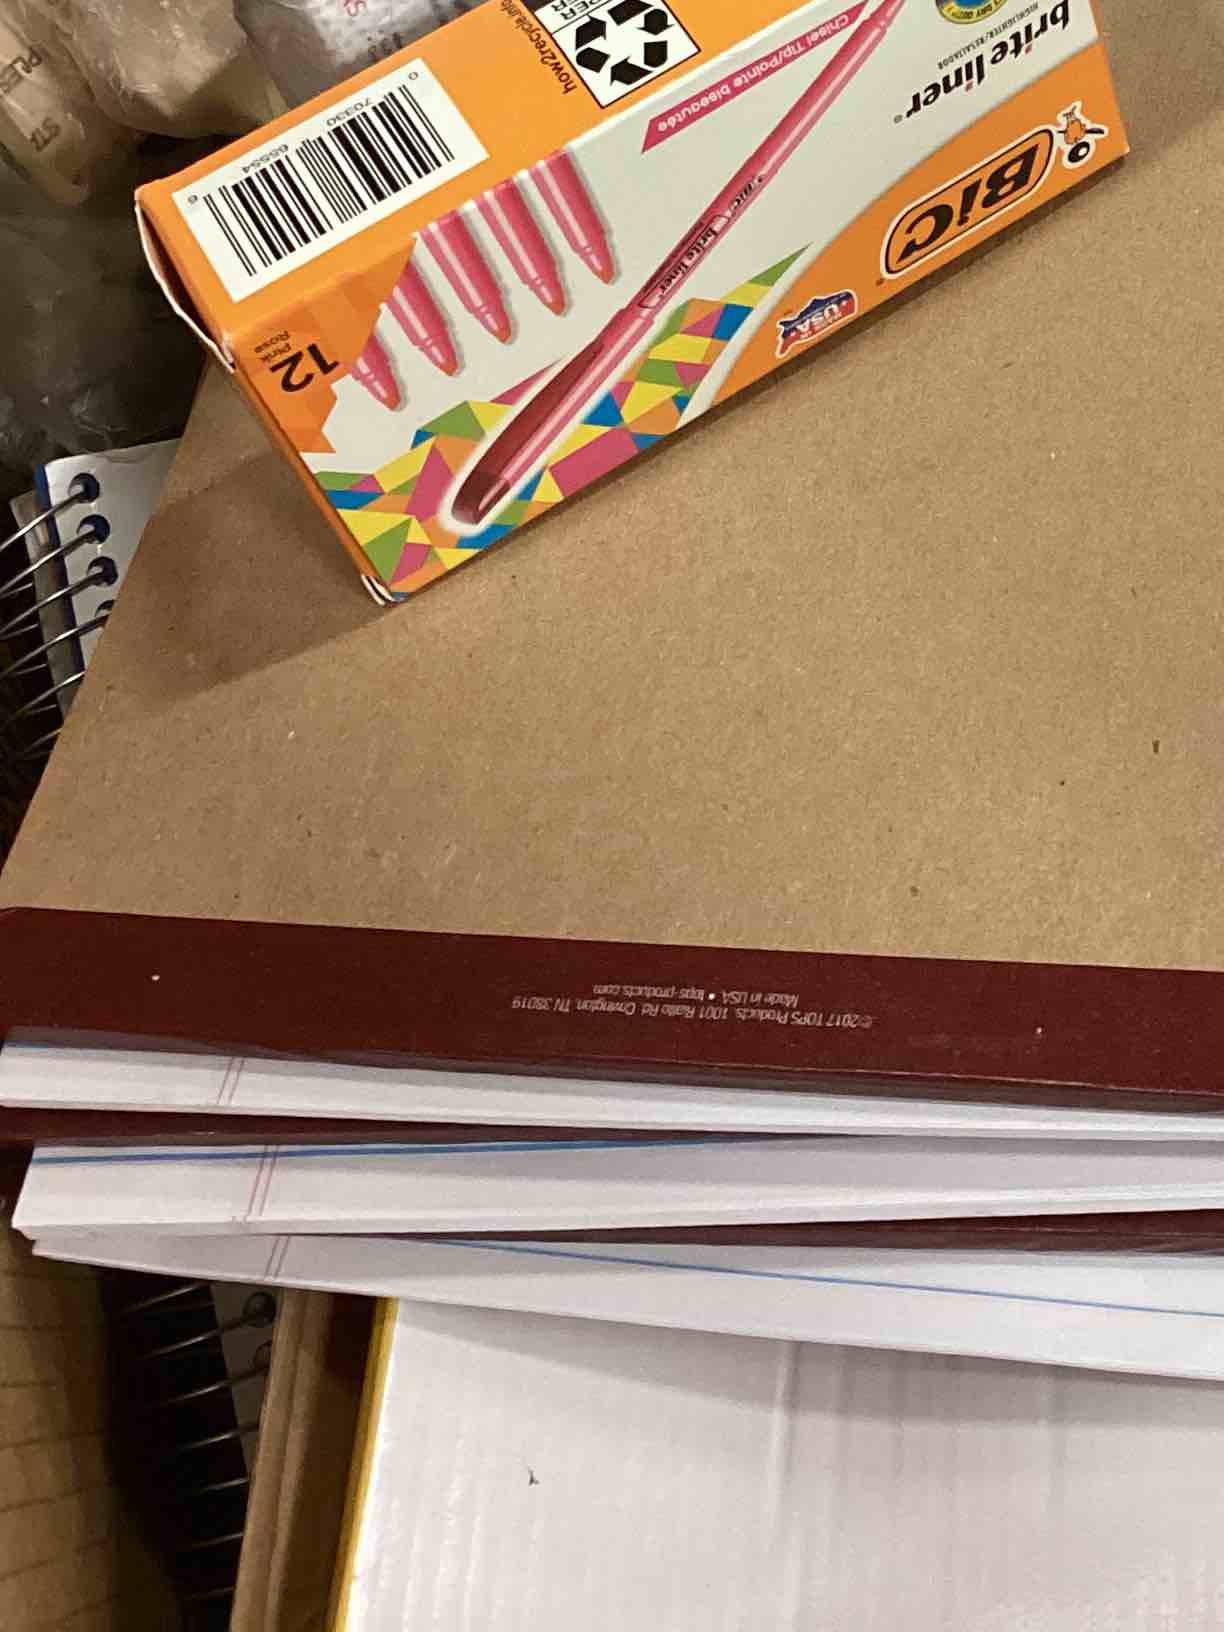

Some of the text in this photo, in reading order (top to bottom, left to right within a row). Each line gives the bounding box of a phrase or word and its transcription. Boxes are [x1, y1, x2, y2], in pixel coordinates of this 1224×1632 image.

[405, 68, 420, 82] 0
[655, 12, 851, 135] Chisel Tip/Pointe biseautée
[910, 55, 987, 120] liner
[324, 94, 373, 129] 70330
[185, 192, 199, 206] 6
[893, 150, 1041, 266] BIC
[269, 336, 340, 398] 12
[721, 989, 748, 1005] USA
[748, 990, 762, 1005] in
[766, 990, 801, 1008] Made
[699, 1004, 729, 1021] 1001
